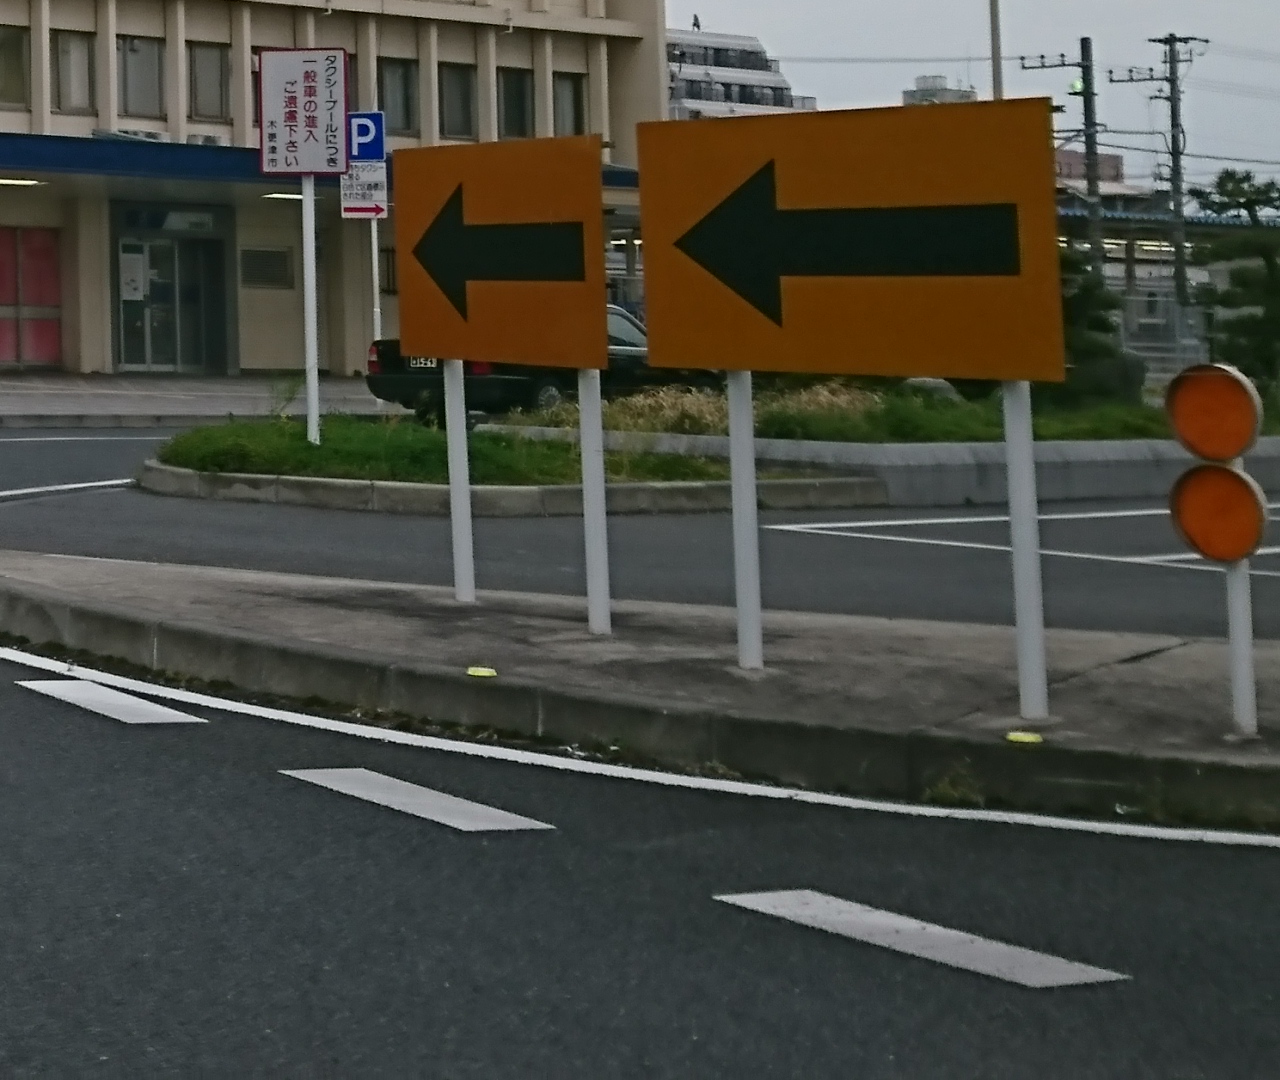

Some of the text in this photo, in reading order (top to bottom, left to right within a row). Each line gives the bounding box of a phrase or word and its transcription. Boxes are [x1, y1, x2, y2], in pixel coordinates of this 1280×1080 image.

[283, 80, 299, 167] ご遠慮下さい
[303, 60, 319, 143] 一般車の進入
[324, 55, 339, 168] タクシープールにつき
[351, 118, 376, 156] P
[267, 121, 278, 168] 木更津市
